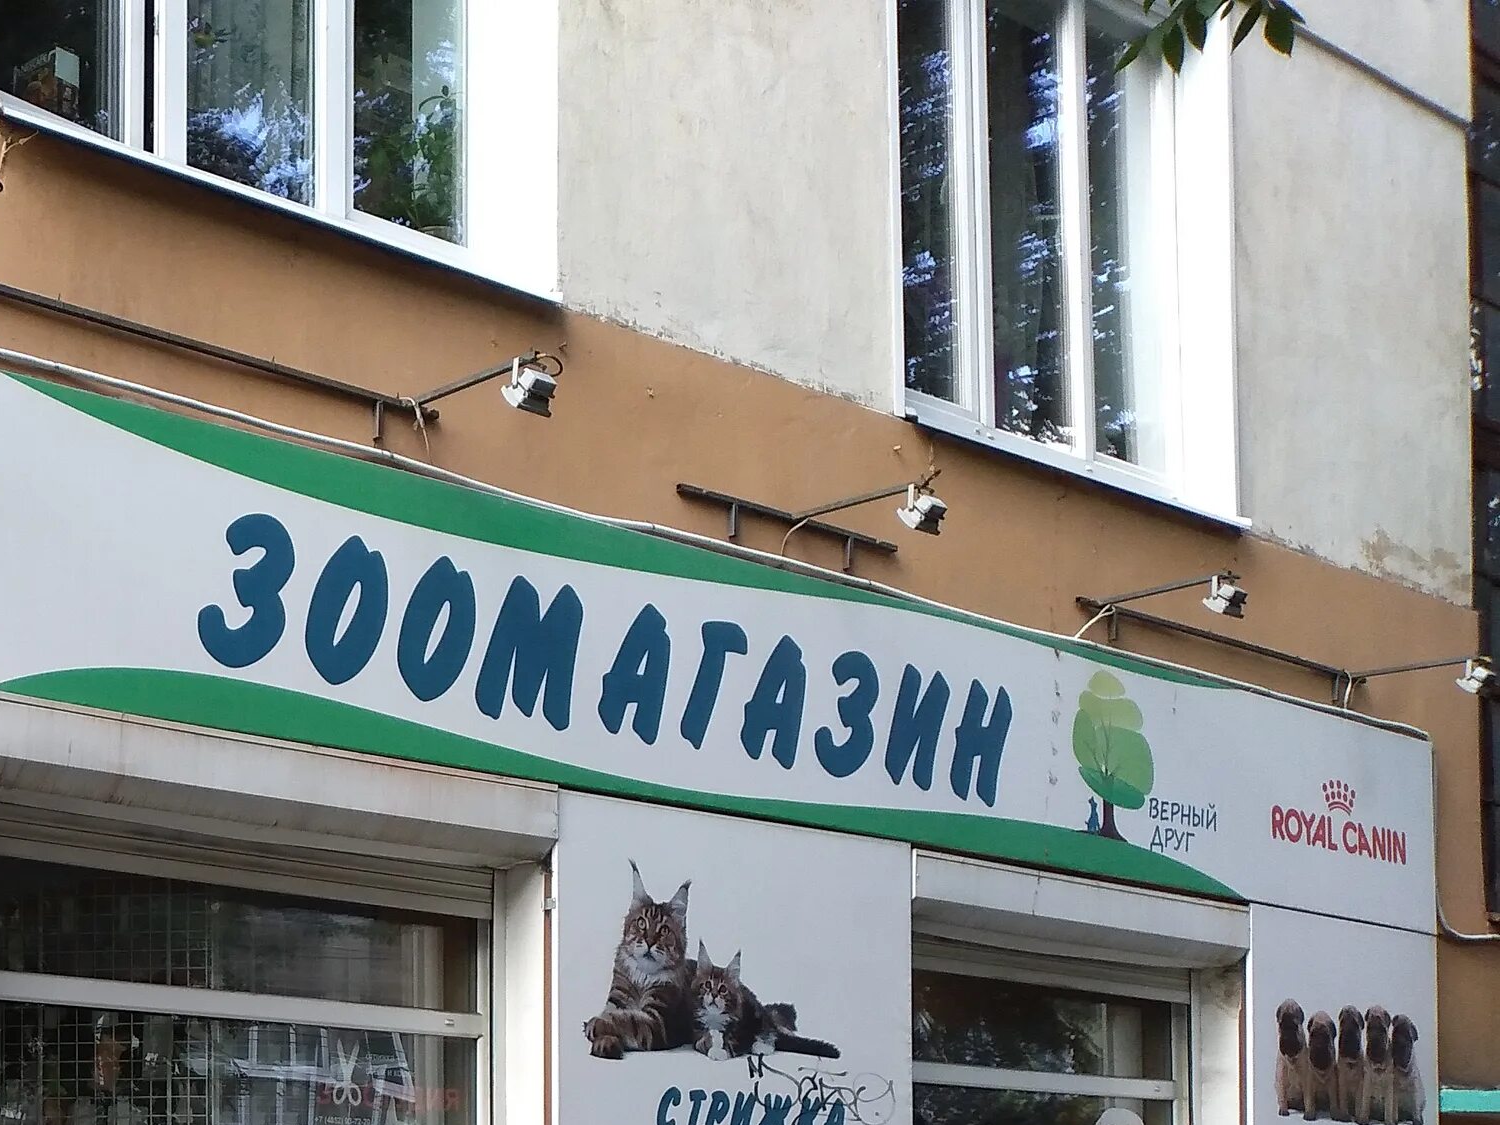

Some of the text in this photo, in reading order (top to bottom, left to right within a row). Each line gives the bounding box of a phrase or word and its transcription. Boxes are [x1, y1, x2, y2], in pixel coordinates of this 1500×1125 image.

[197, 512, 1013, 807] ЗООМАГАЗИН
[1148, 797, 1218, 832] ВЕРНЫЙ
[1271, 805, 1407, 865] ROYAL CANIN
[1149, 828, 1196, 853] ДРУГ
